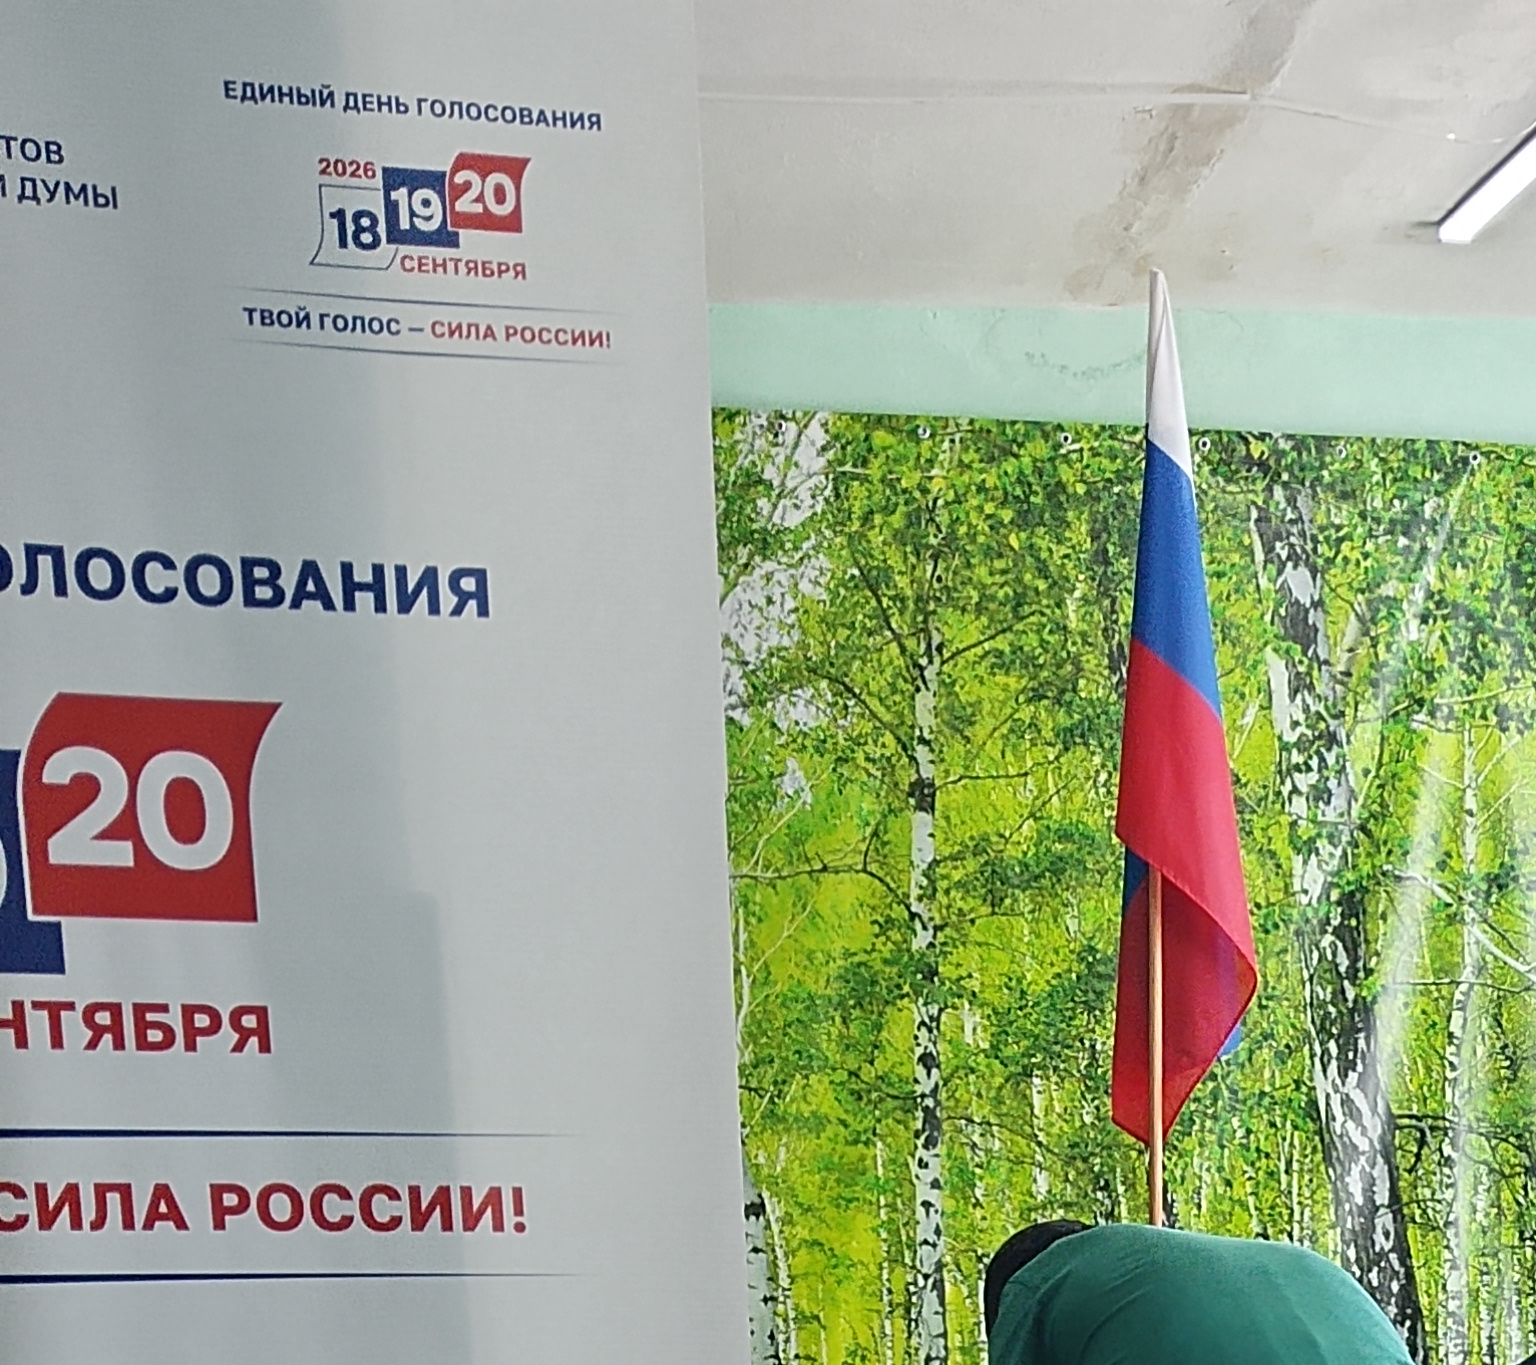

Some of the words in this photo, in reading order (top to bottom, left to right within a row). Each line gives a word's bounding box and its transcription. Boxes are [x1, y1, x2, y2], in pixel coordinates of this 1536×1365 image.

[223, 80, 336, 109] ЕДИНЫЙ
[342, 91, 410, 115] ДЕНЬ
[416, 97, 602, 132] ГОЛОСОВАНИЯ
[317, 157, 377, 180] 2026
[16, 176, 118, 210] ДУМЫ
[328, 207, 382, 252] 18
[391, 187, 440, 231] 19
[454, 170, 515, 215] 20
[399, 254, 527, 281] СЕНТЯБРЯ
[242, 305, 312, 330] ТВОЙ
[318, 312, 401, 336] ГОЛОС
[430, 320, 498, 342] СИЛА
[504, 325, 611, 349] РОССИИ!
[42, 745, 233, 870] 20
[208, 1182, 527, 1234] РОССИИ!
